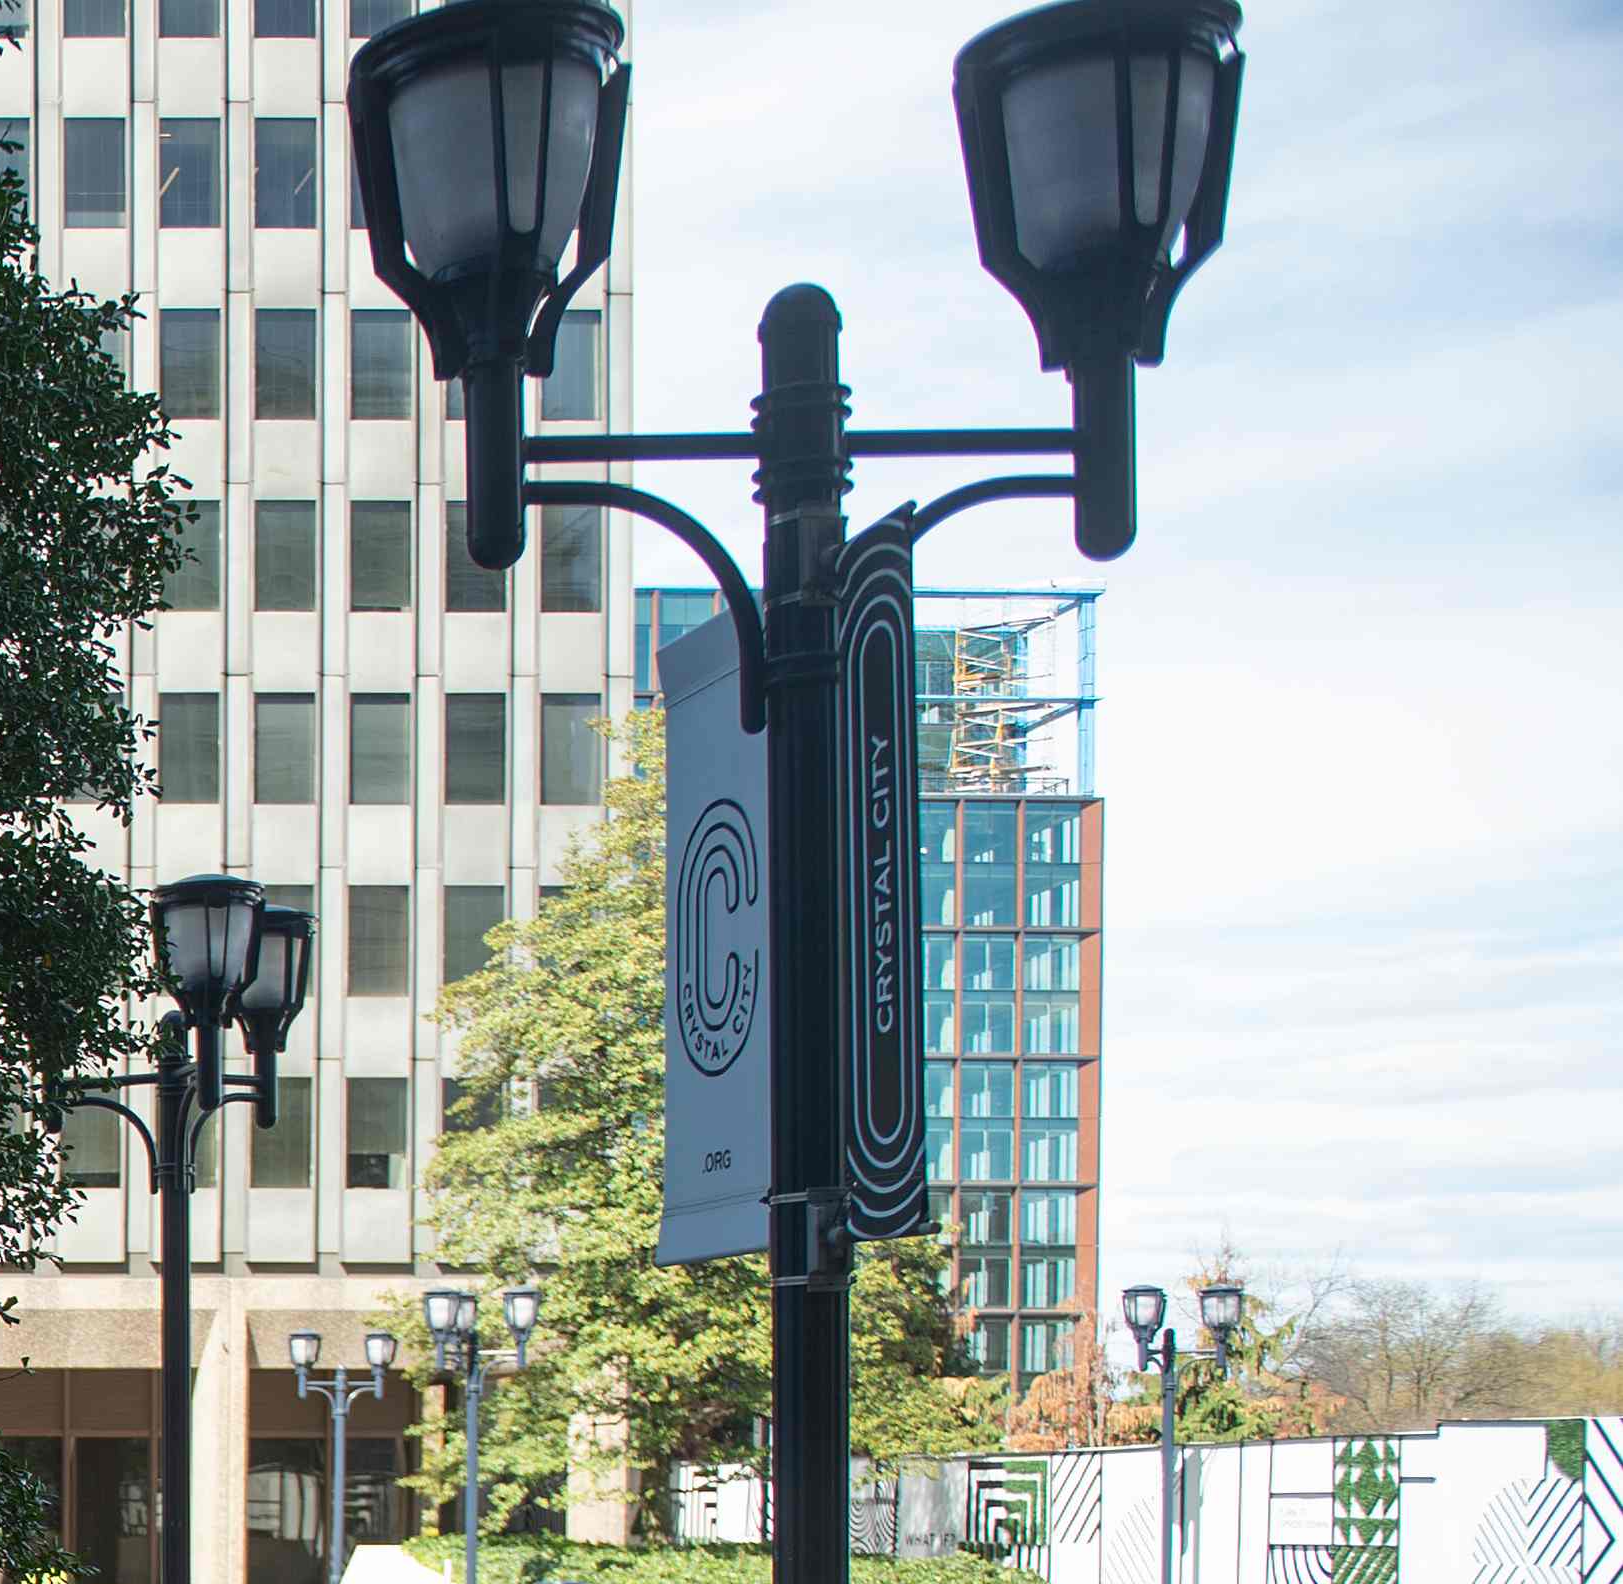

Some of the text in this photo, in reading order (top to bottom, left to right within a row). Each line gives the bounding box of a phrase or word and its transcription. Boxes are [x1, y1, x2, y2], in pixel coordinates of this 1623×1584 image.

[871, 735, 894, 1033] CRYSTAL CITY
[683, 964, 752, 1061] CRYSTAL CITY
[703, 1149, 732, 1174] .ORG
